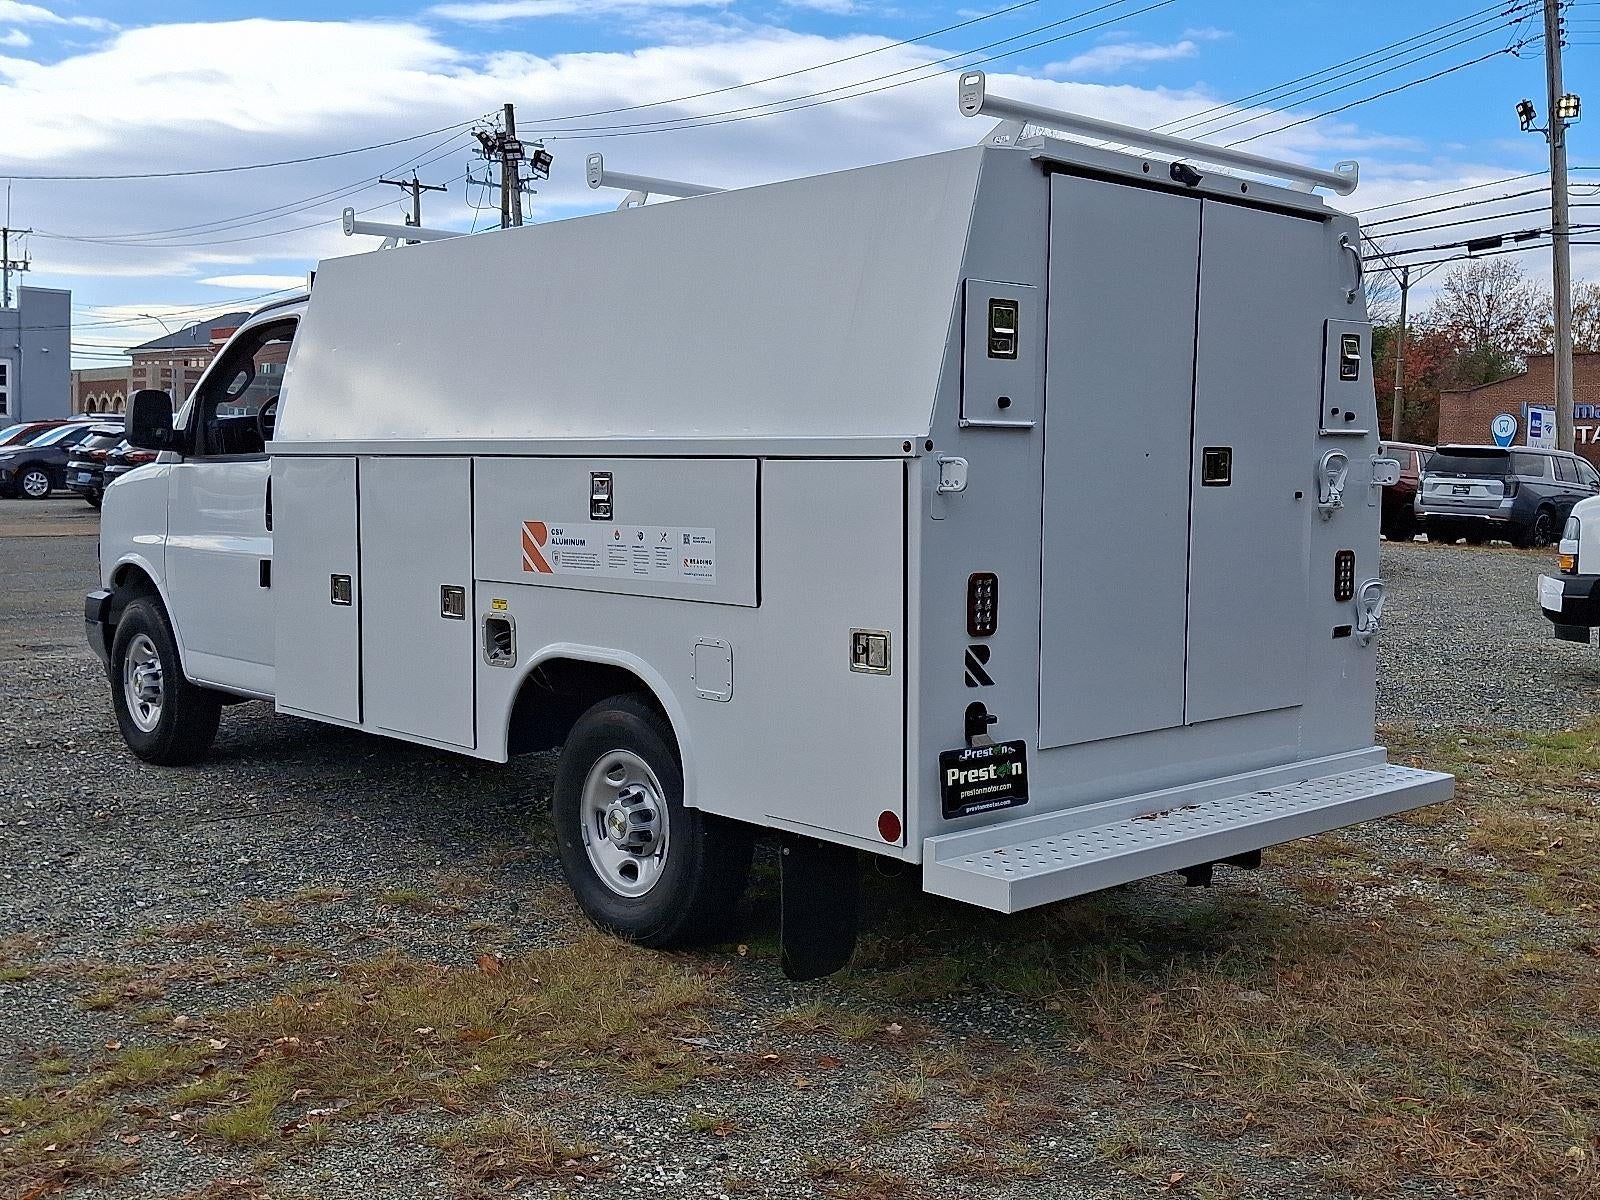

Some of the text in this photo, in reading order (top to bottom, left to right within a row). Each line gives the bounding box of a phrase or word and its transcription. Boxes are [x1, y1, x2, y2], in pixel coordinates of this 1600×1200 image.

[550, 528, 564, 536] CSV
[551, 538, 586, 546] ALUMINUM
[960, 783, 1012, 800] prestonmotor.com
